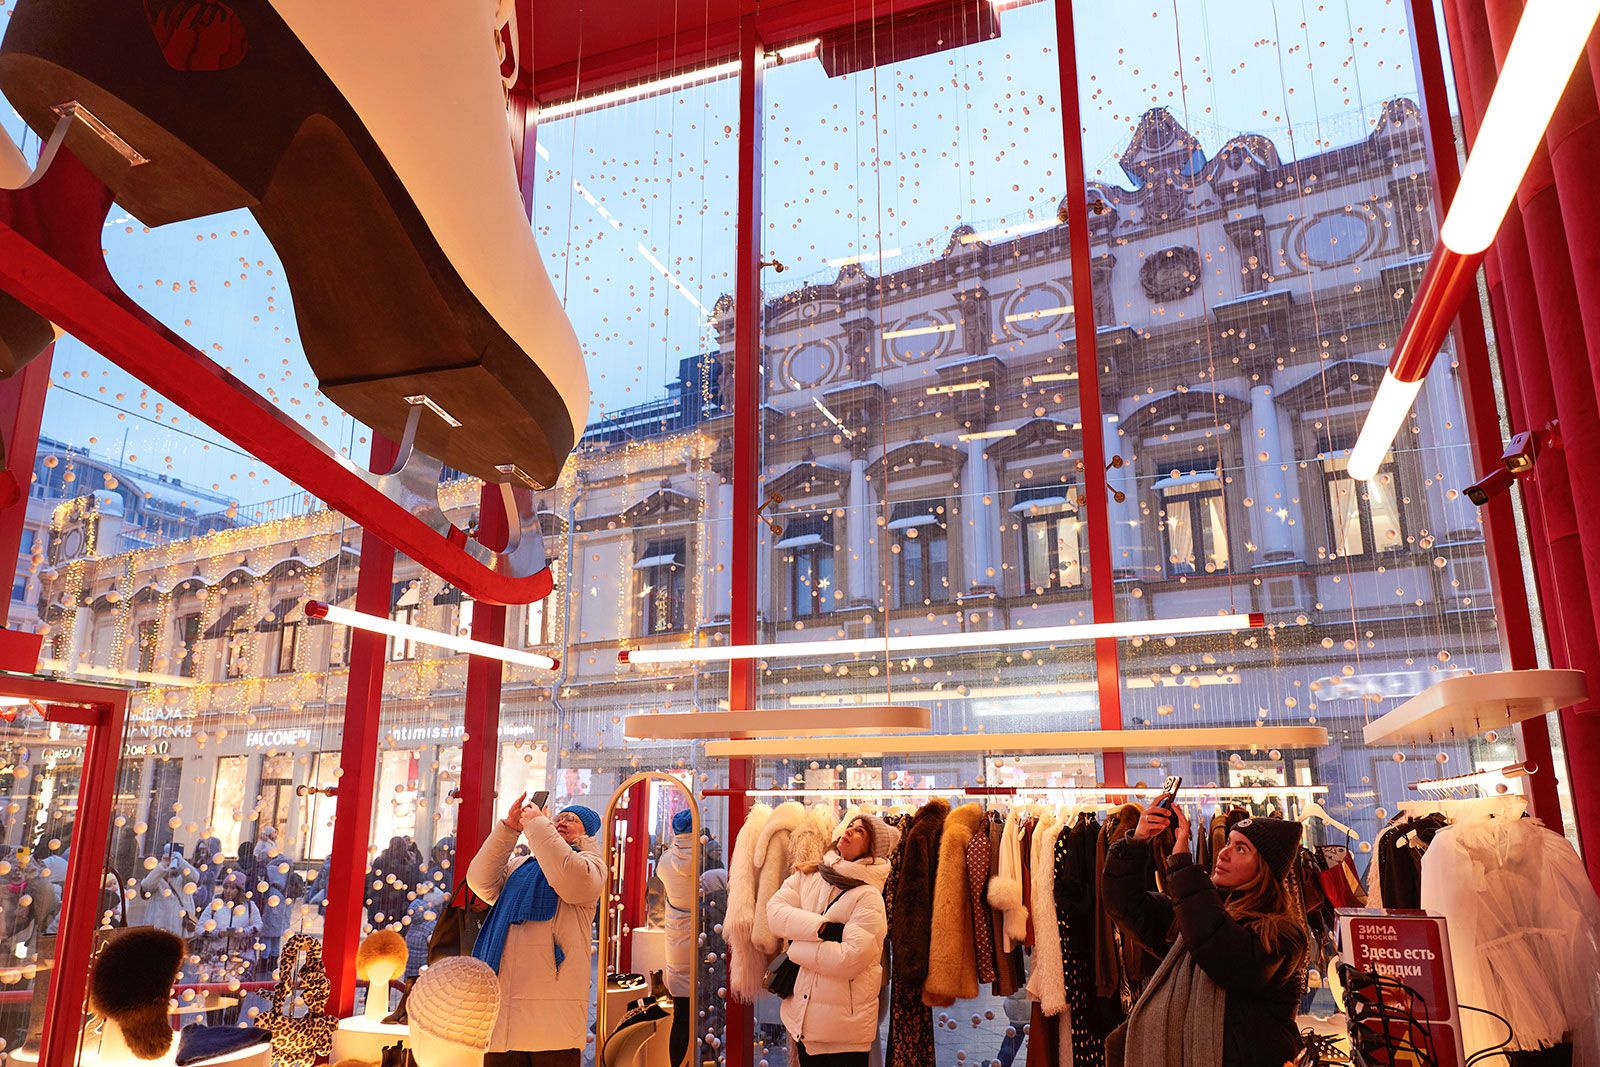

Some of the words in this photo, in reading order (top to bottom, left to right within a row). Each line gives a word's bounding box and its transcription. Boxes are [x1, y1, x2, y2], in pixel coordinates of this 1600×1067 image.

[131, 744, 157, 755] OMEA
[1358, 925, 1397, 934] ЗИМА
[1360, 944, 1402, 960] Здесь
[1403, 948, 1436, 960] есть
[1363, 964, 1422, 978] зрядки
